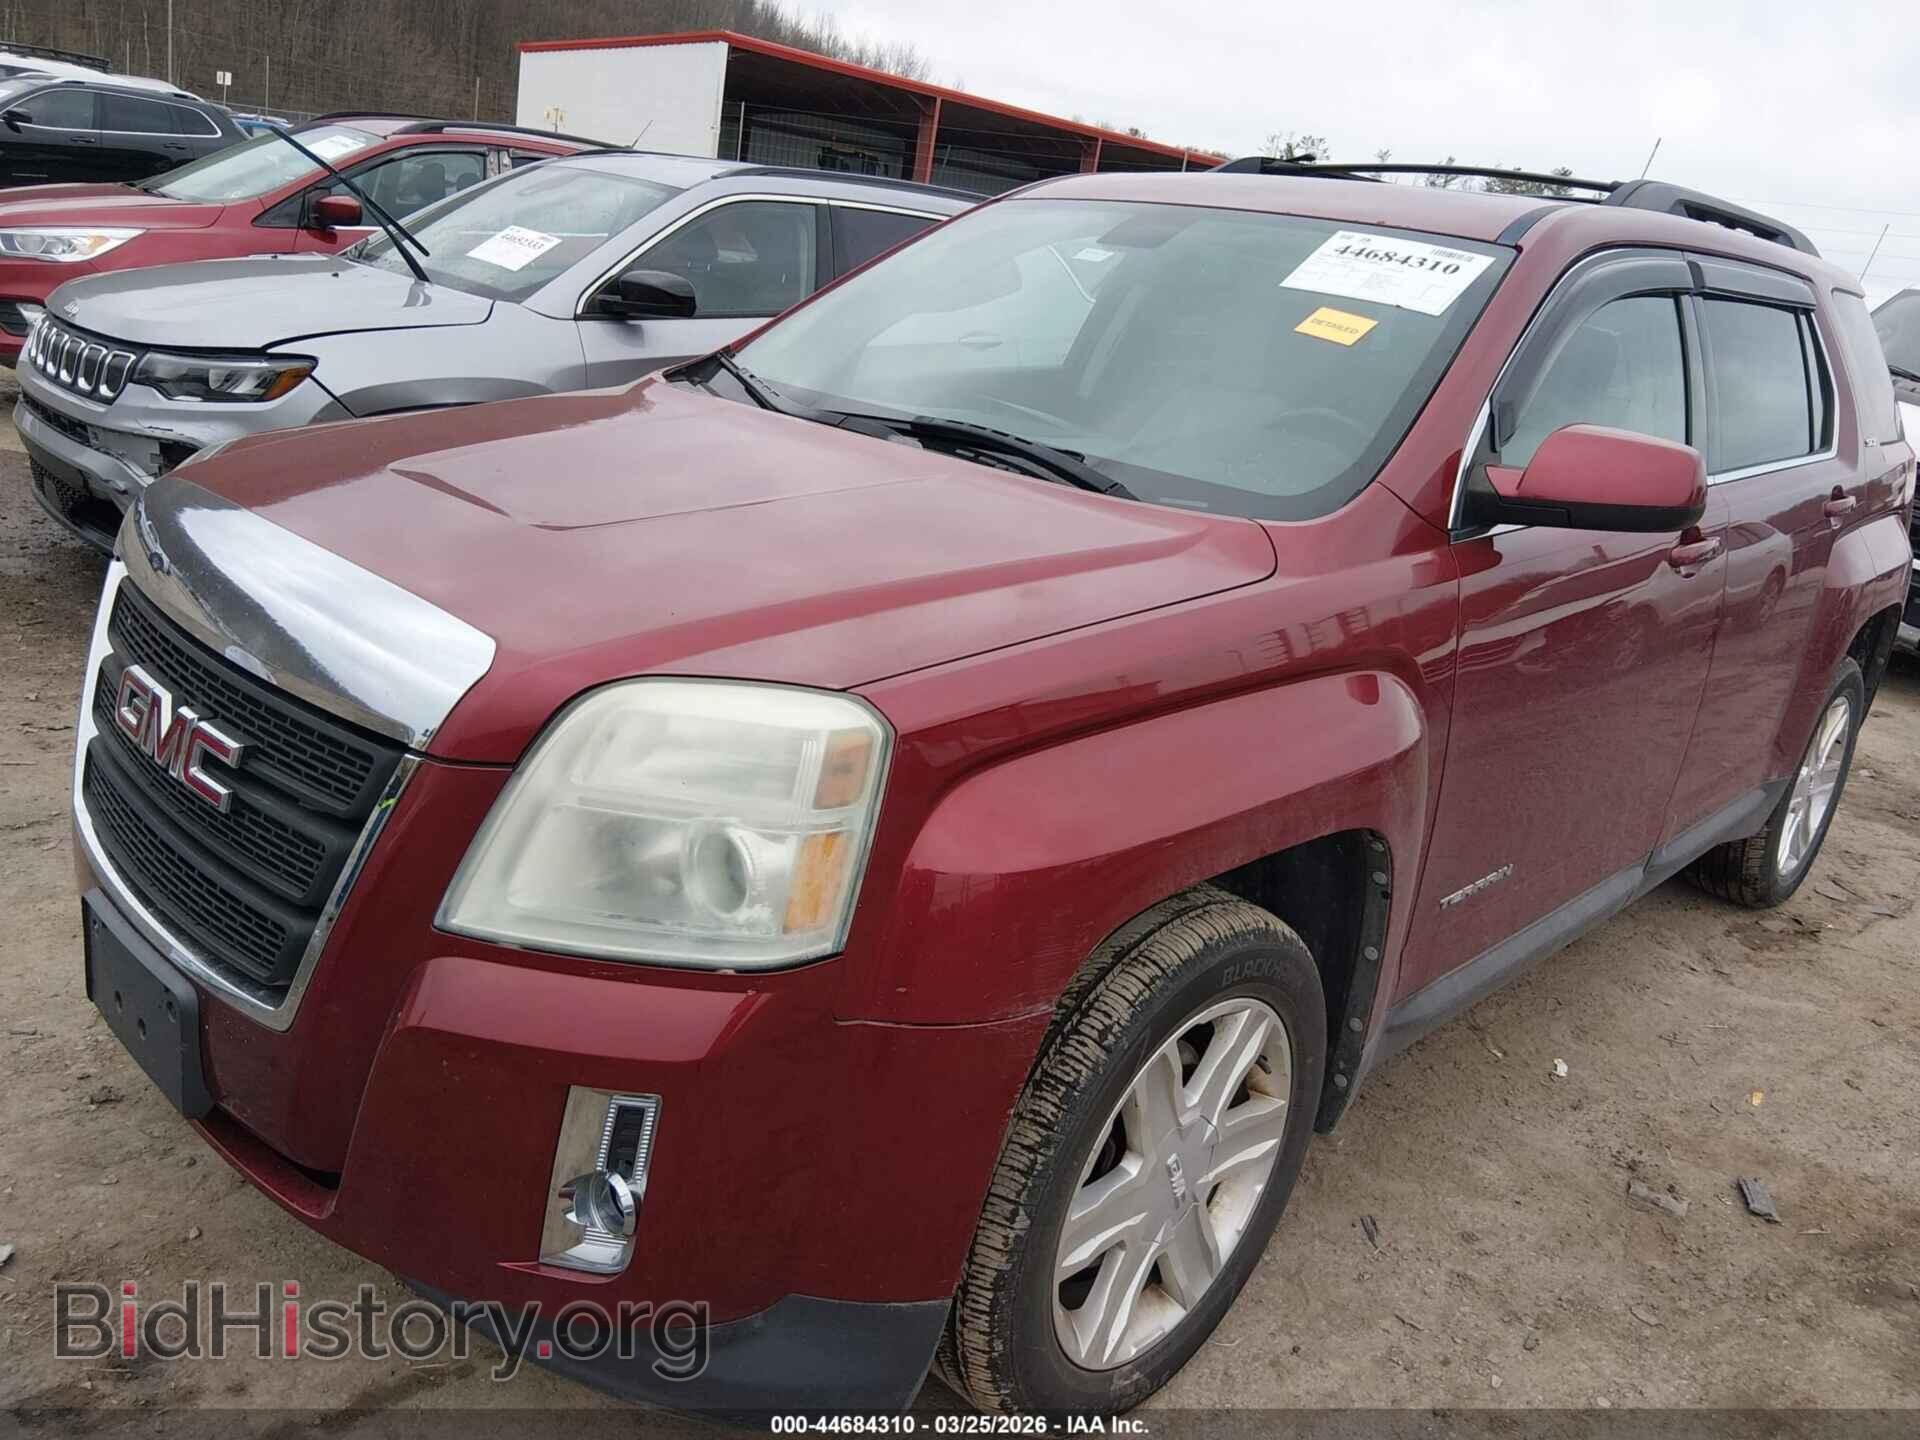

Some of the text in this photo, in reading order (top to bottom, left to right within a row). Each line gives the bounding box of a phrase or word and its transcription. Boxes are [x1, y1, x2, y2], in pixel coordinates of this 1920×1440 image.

[1334, 245, 1461, 275] 44684310
[1310, 318, 1360, 335] DETAILED
[115, 664, 245, 814] GMC
